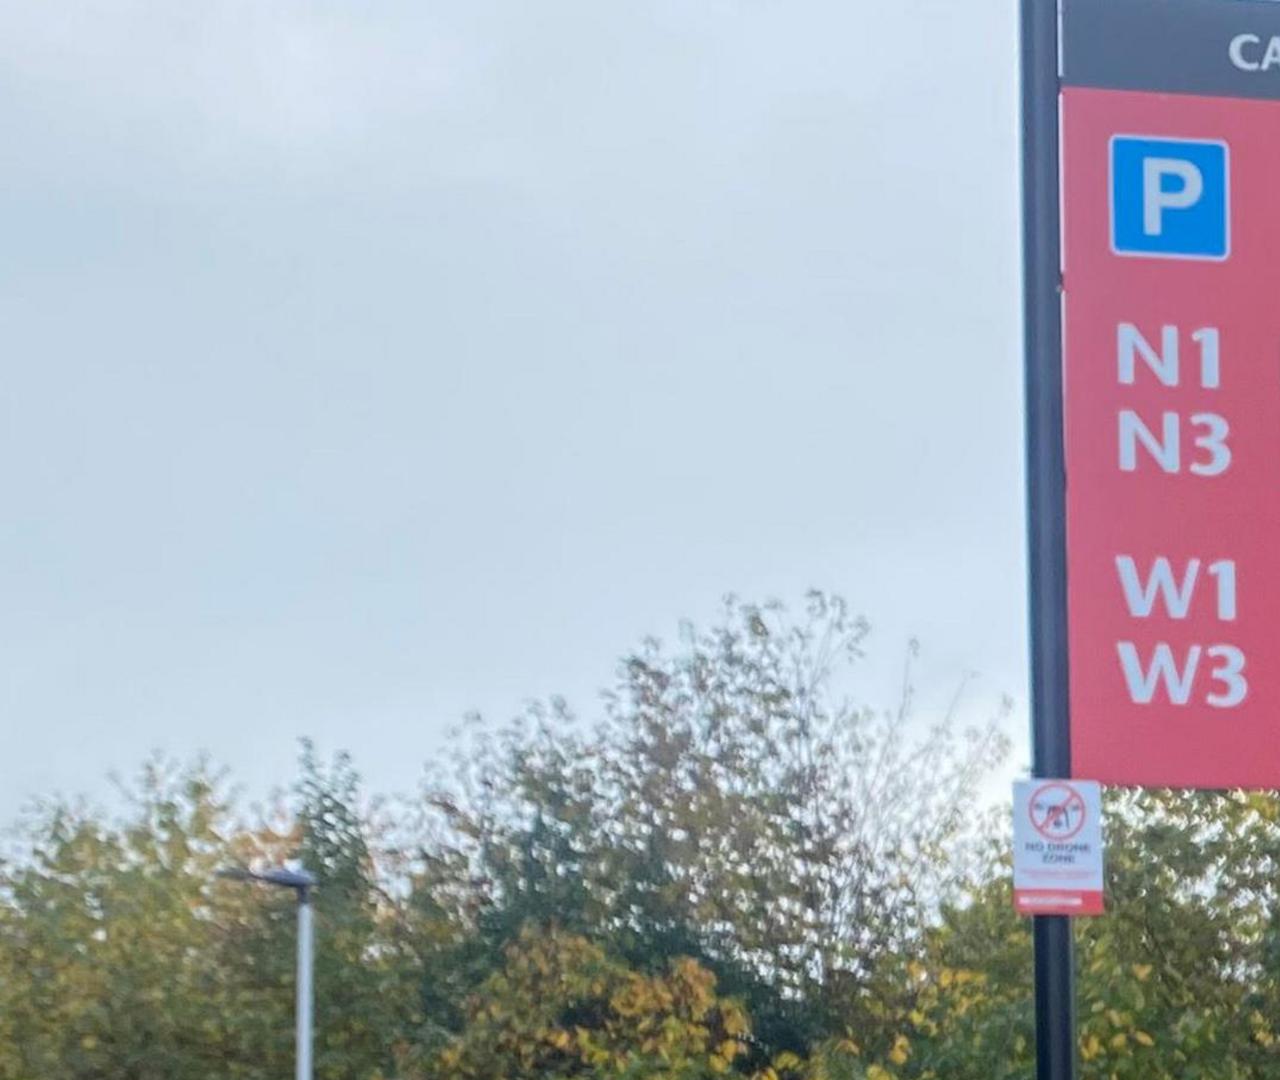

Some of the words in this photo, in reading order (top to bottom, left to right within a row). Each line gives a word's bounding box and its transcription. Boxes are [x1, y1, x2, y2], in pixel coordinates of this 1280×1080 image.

[1143, 157, 1204, 236] P
[1117, 322, 1220, 389] N1
[1118, 409, 1232, 476] N3
[1115, 555, 1237, 621] W1
[1116, 641, 1248, 708] W3
